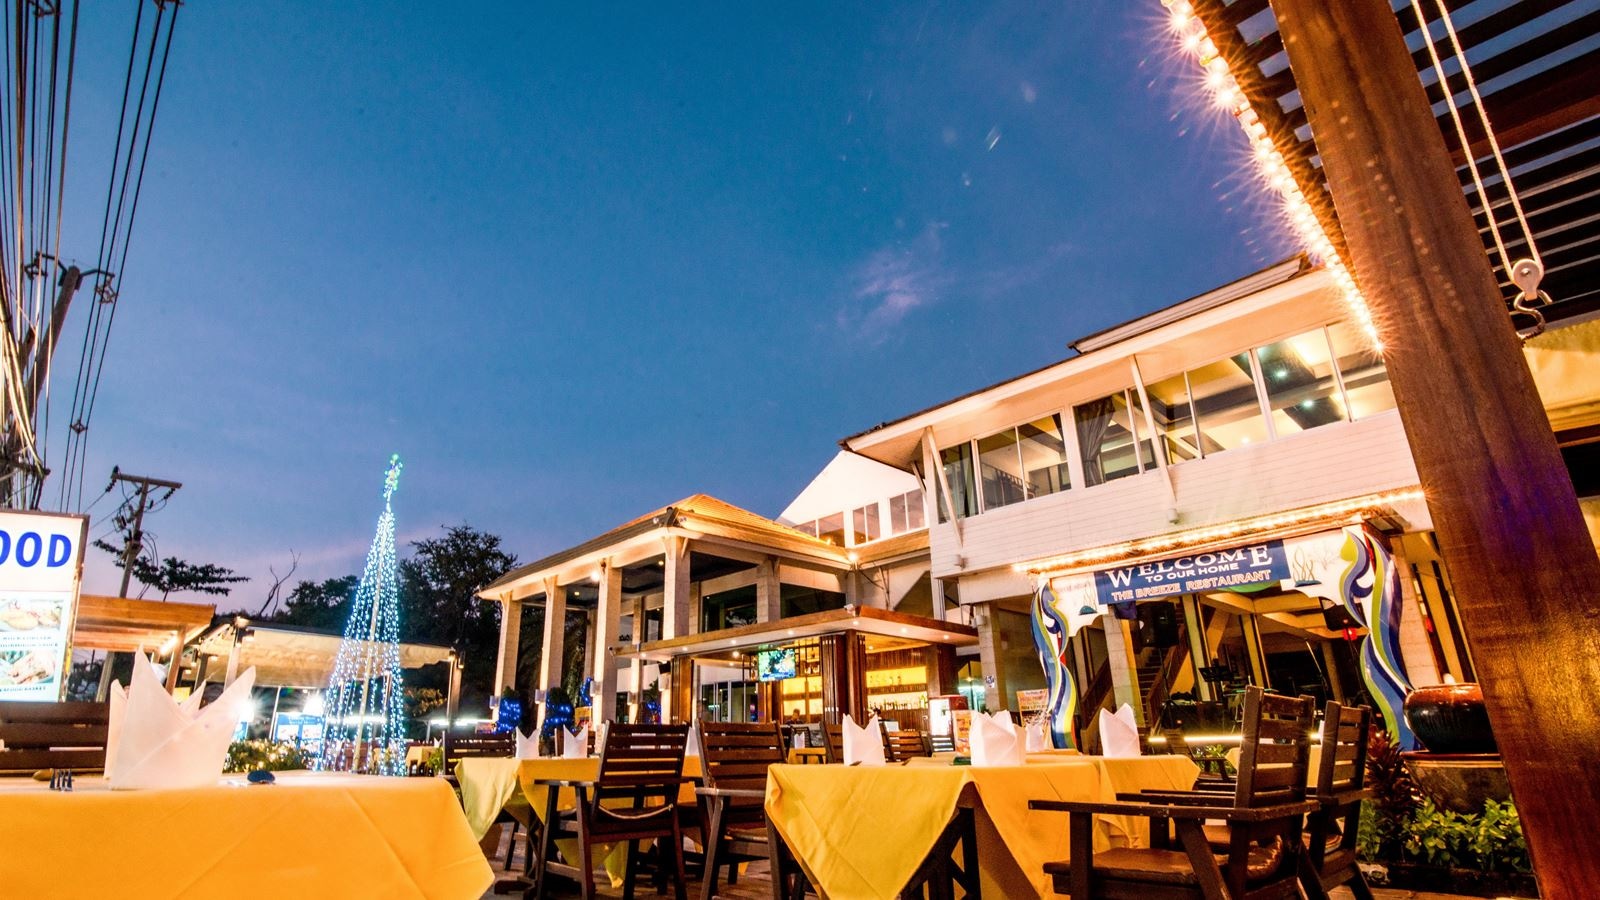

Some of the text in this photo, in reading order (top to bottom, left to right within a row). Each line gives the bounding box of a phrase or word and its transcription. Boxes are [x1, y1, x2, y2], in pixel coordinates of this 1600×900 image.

[1105, 545, 1273, 588] WELCOME
[1145, 562, 1239, 583] TO OUR HOME
[1111, 569, 1272, 601] THE BREEZE RESTAURANT
